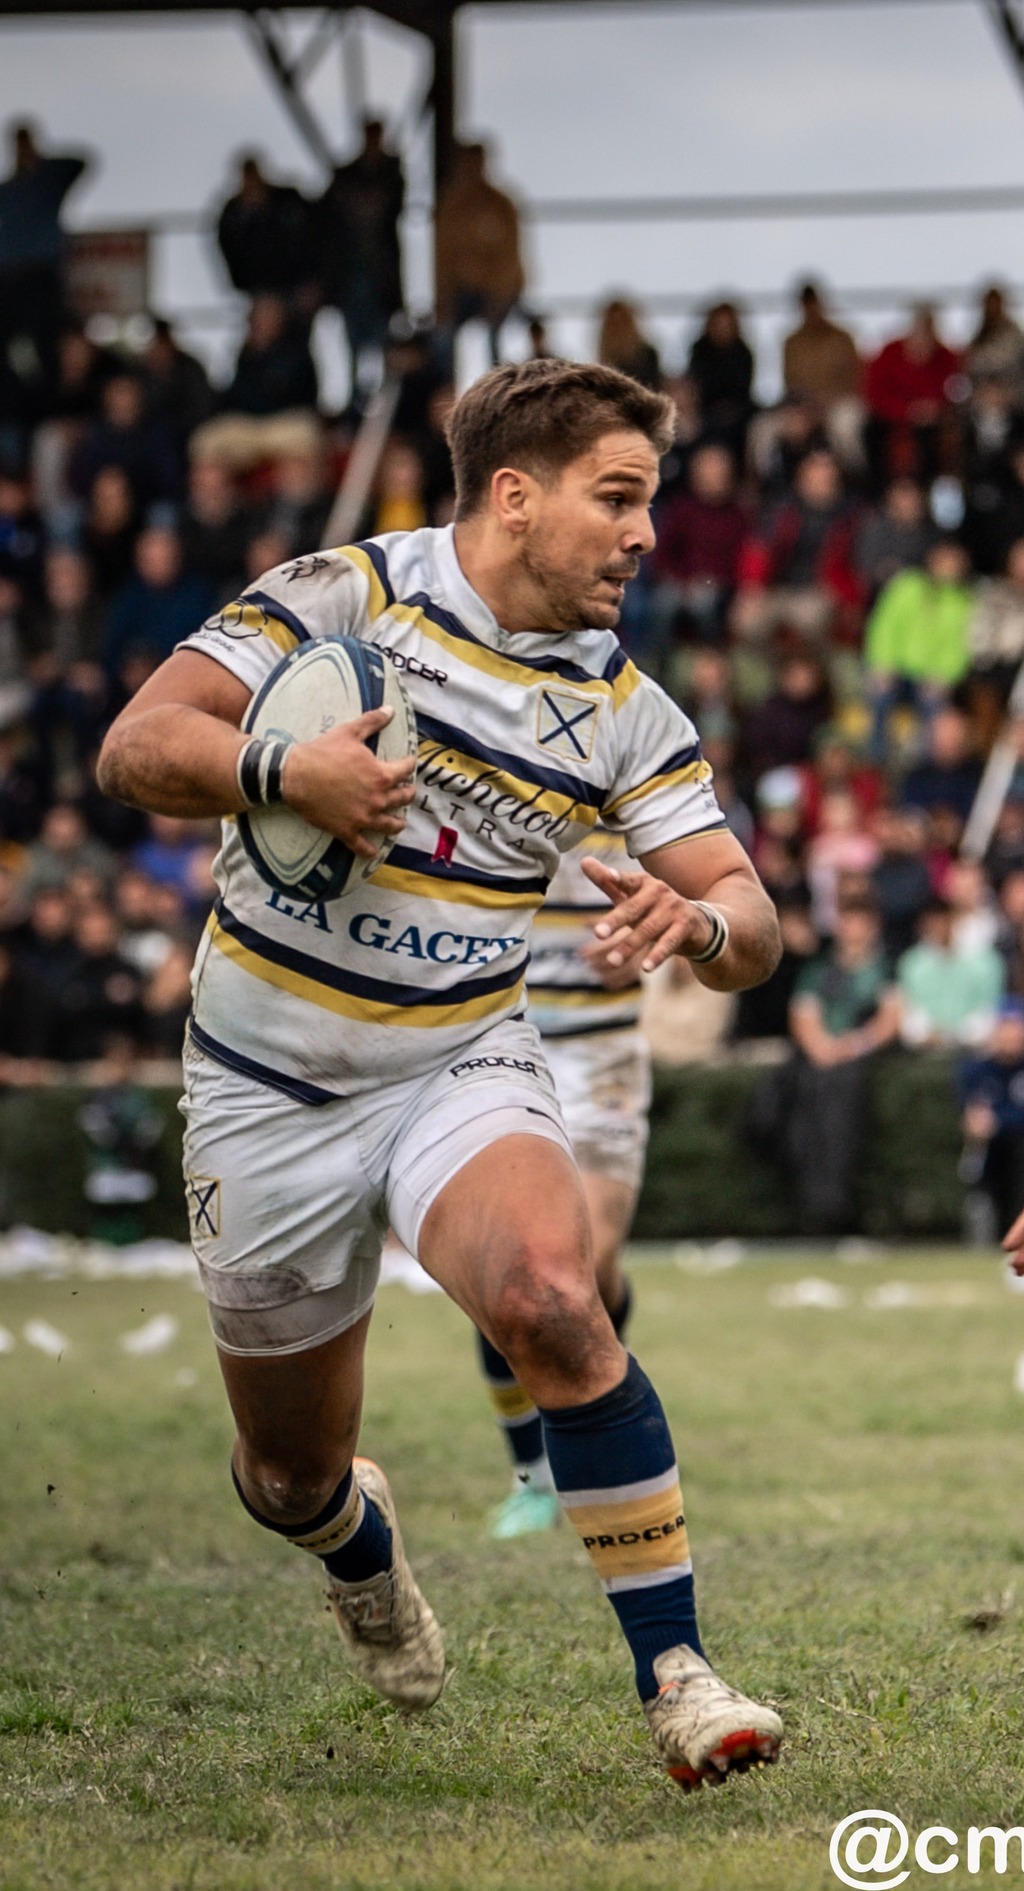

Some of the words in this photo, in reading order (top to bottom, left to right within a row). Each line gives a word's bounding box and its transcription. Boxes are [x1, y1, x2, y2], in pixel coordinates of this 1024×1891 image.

[419, 794, 526, 850] LTRA
[348, 913, 525, 965] GACET
[449, 1056, 539, 1078] PROCER
